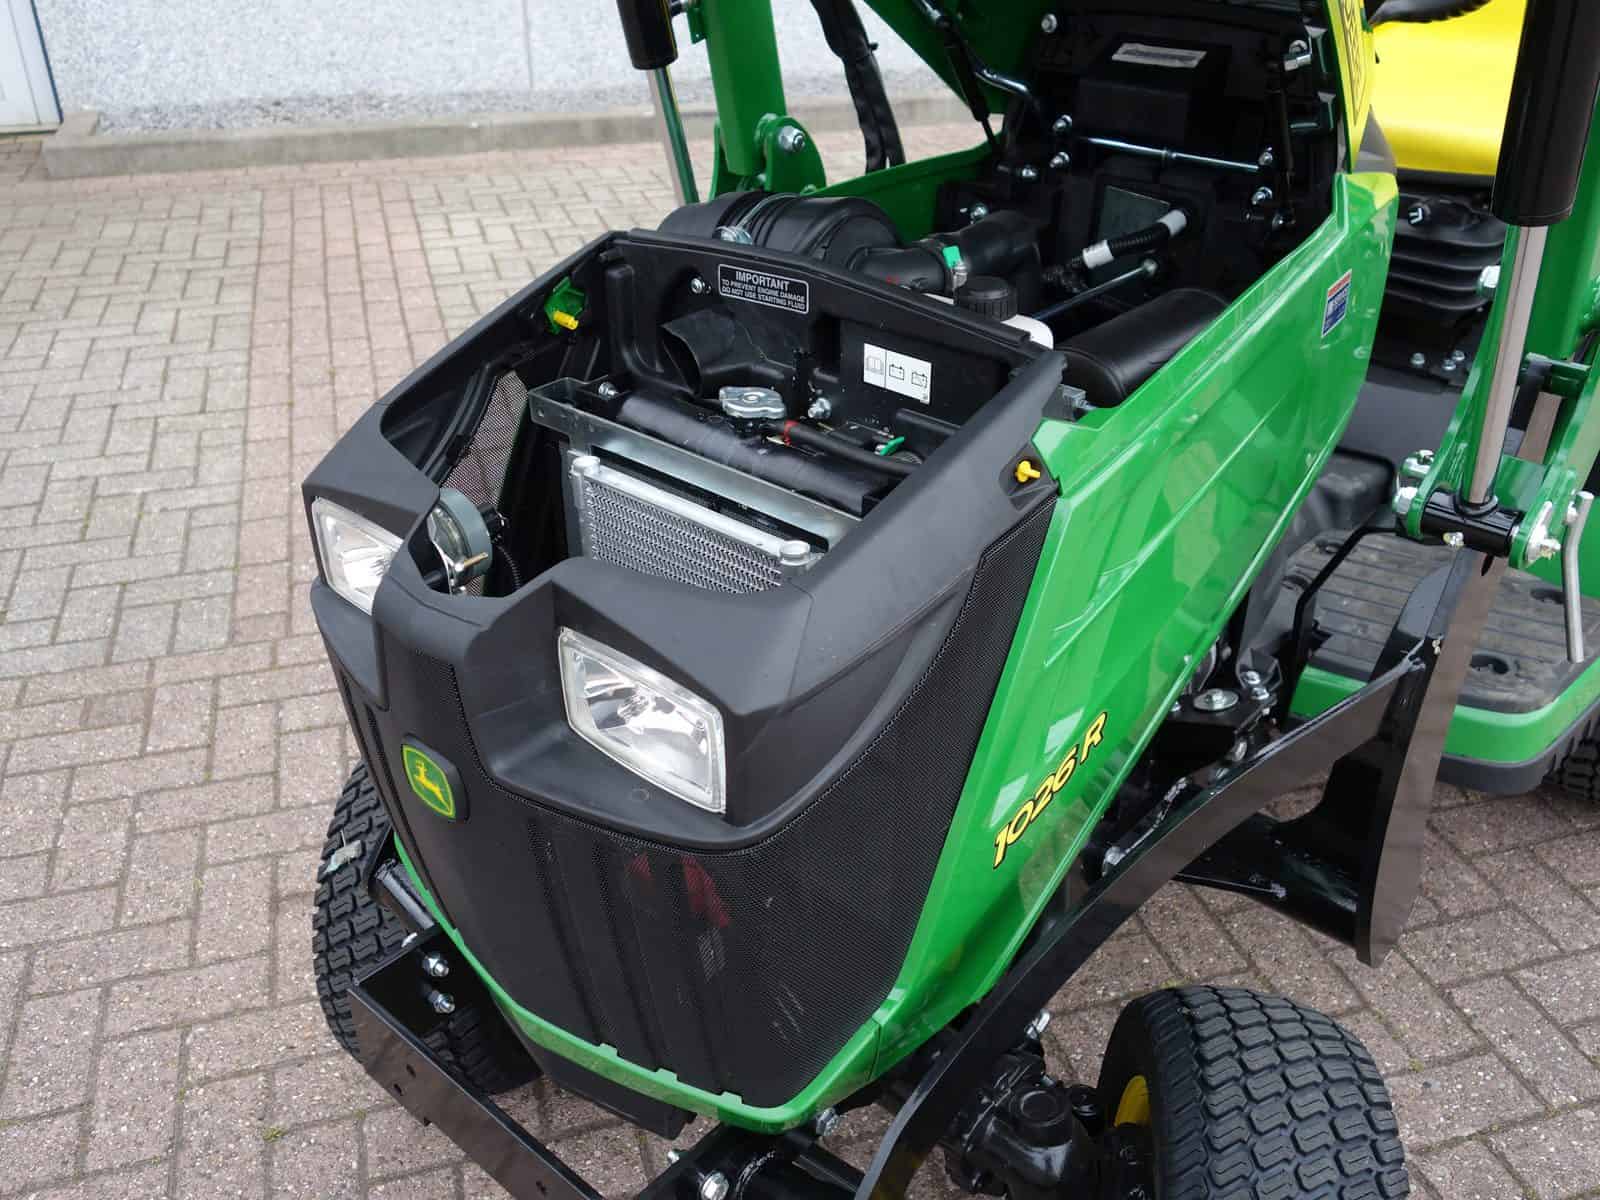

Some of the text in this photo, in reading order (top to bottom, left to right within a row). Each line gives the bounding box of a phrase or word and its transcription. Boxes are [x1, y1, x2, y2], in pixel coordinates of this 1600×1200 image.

[730, 280, 757, 293] PREVENT
[757, 286, 779, 297] ENGINE
[780, 291, 805, 302] DAMAGE
[735, 271, 790, 291] IMPORTANT
[731, 288, 744, 296] NOT
[744, 291, 757, 299] USE
[757, 294, 787, 306] STARTING
[787, 300, 805, 310] FLUID
